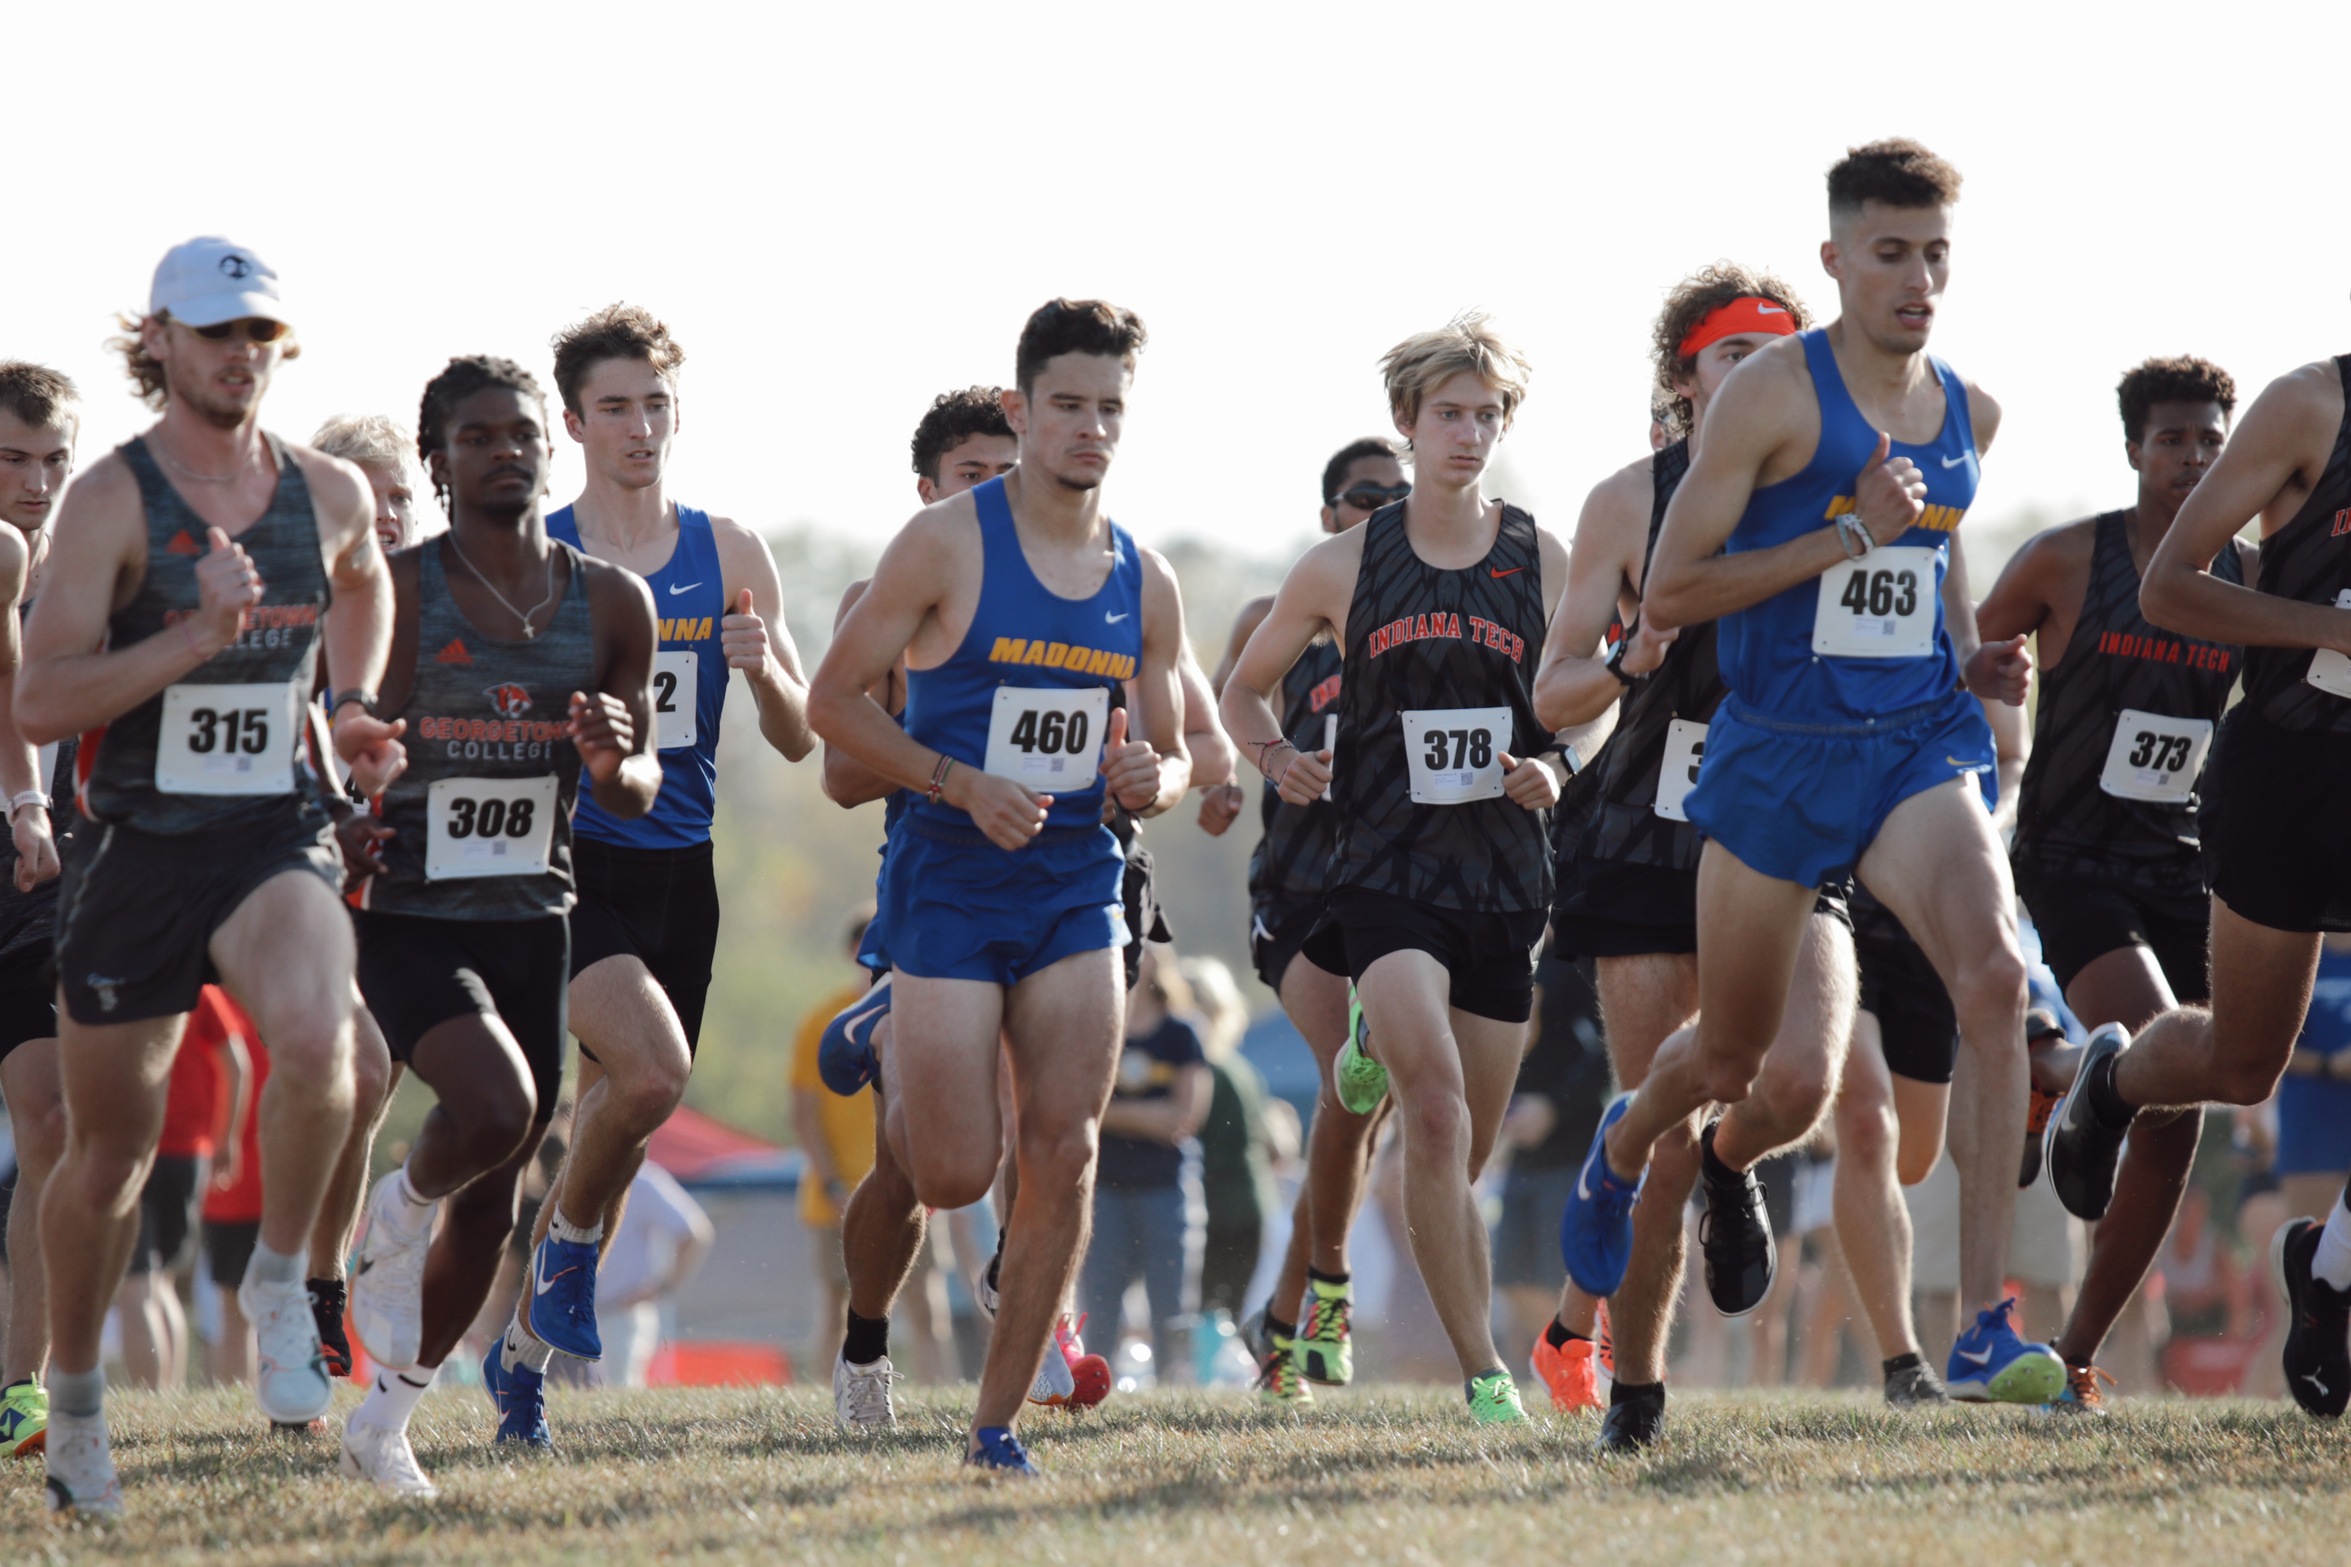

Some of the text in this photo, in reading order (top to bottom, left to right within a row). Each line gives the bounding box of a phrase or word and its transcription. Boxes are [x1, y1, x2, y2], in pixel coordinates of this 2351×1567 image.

[1841, 569, 1917, 617] 463
[988, 637, 1136, 680] MADONNA
[1368, 613, 1525, 664] INDIANA TECH
[2098, 631, 2231, 673] INDIANA TECH
[188, 708, 268, 755] 315
[1010, 709, 1089, 755] 460
[1423, 728, 1493, 771] 378
[2129, 730, 2193, 773] 373
[447, 797, 535, 839] 308
